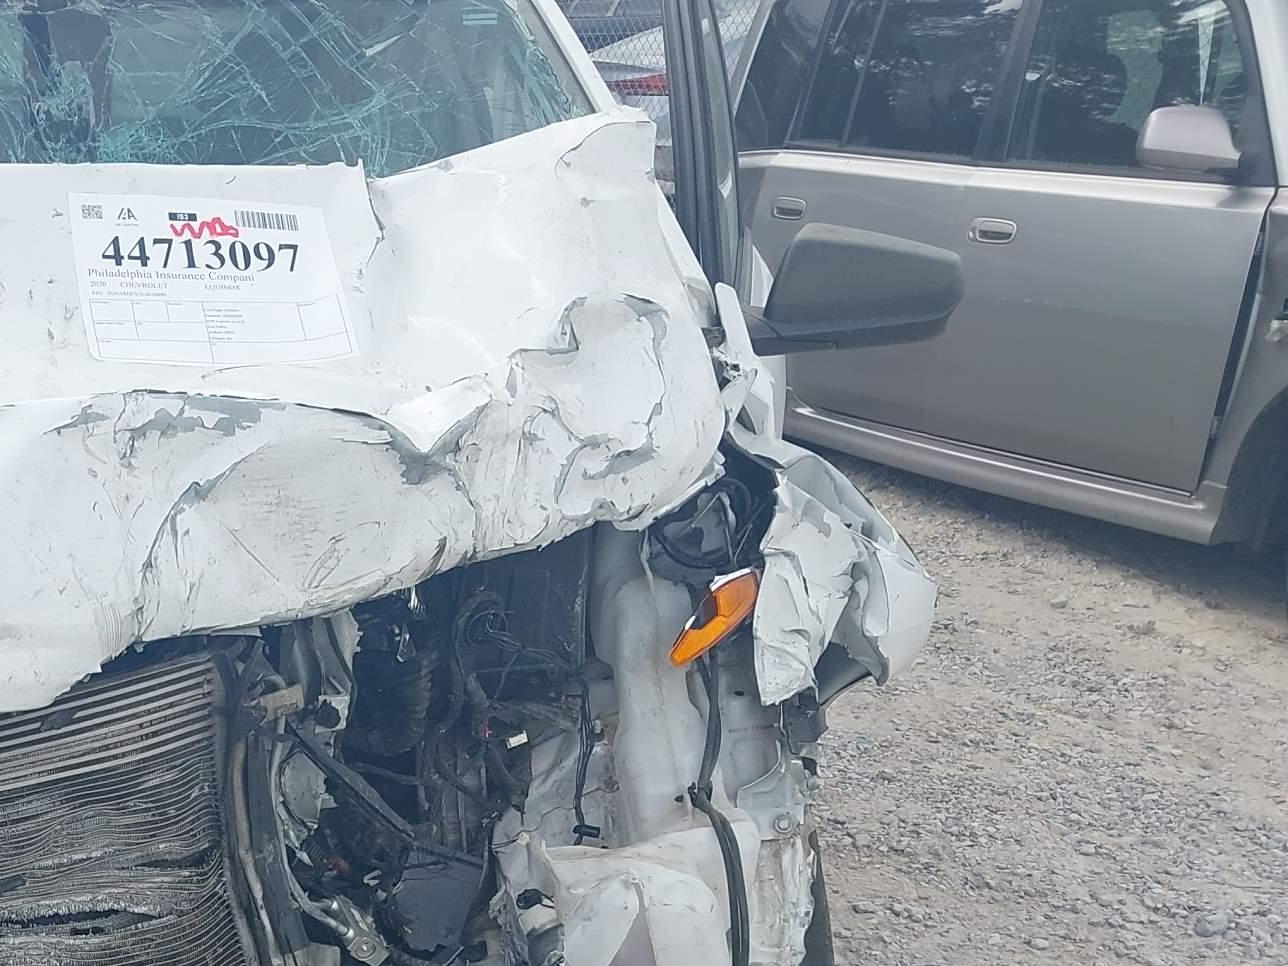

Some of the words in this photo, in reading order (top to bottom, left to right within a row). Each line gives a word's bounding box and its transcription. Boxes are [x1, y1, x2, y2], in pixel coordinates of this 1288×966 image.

[101, 235, 299, 272] 44713097
[88, 268, 153, 280] Philadelphia
[156, 271, 205, 281] Insurance
[120, 281, 167, 289] CHEVROLET
